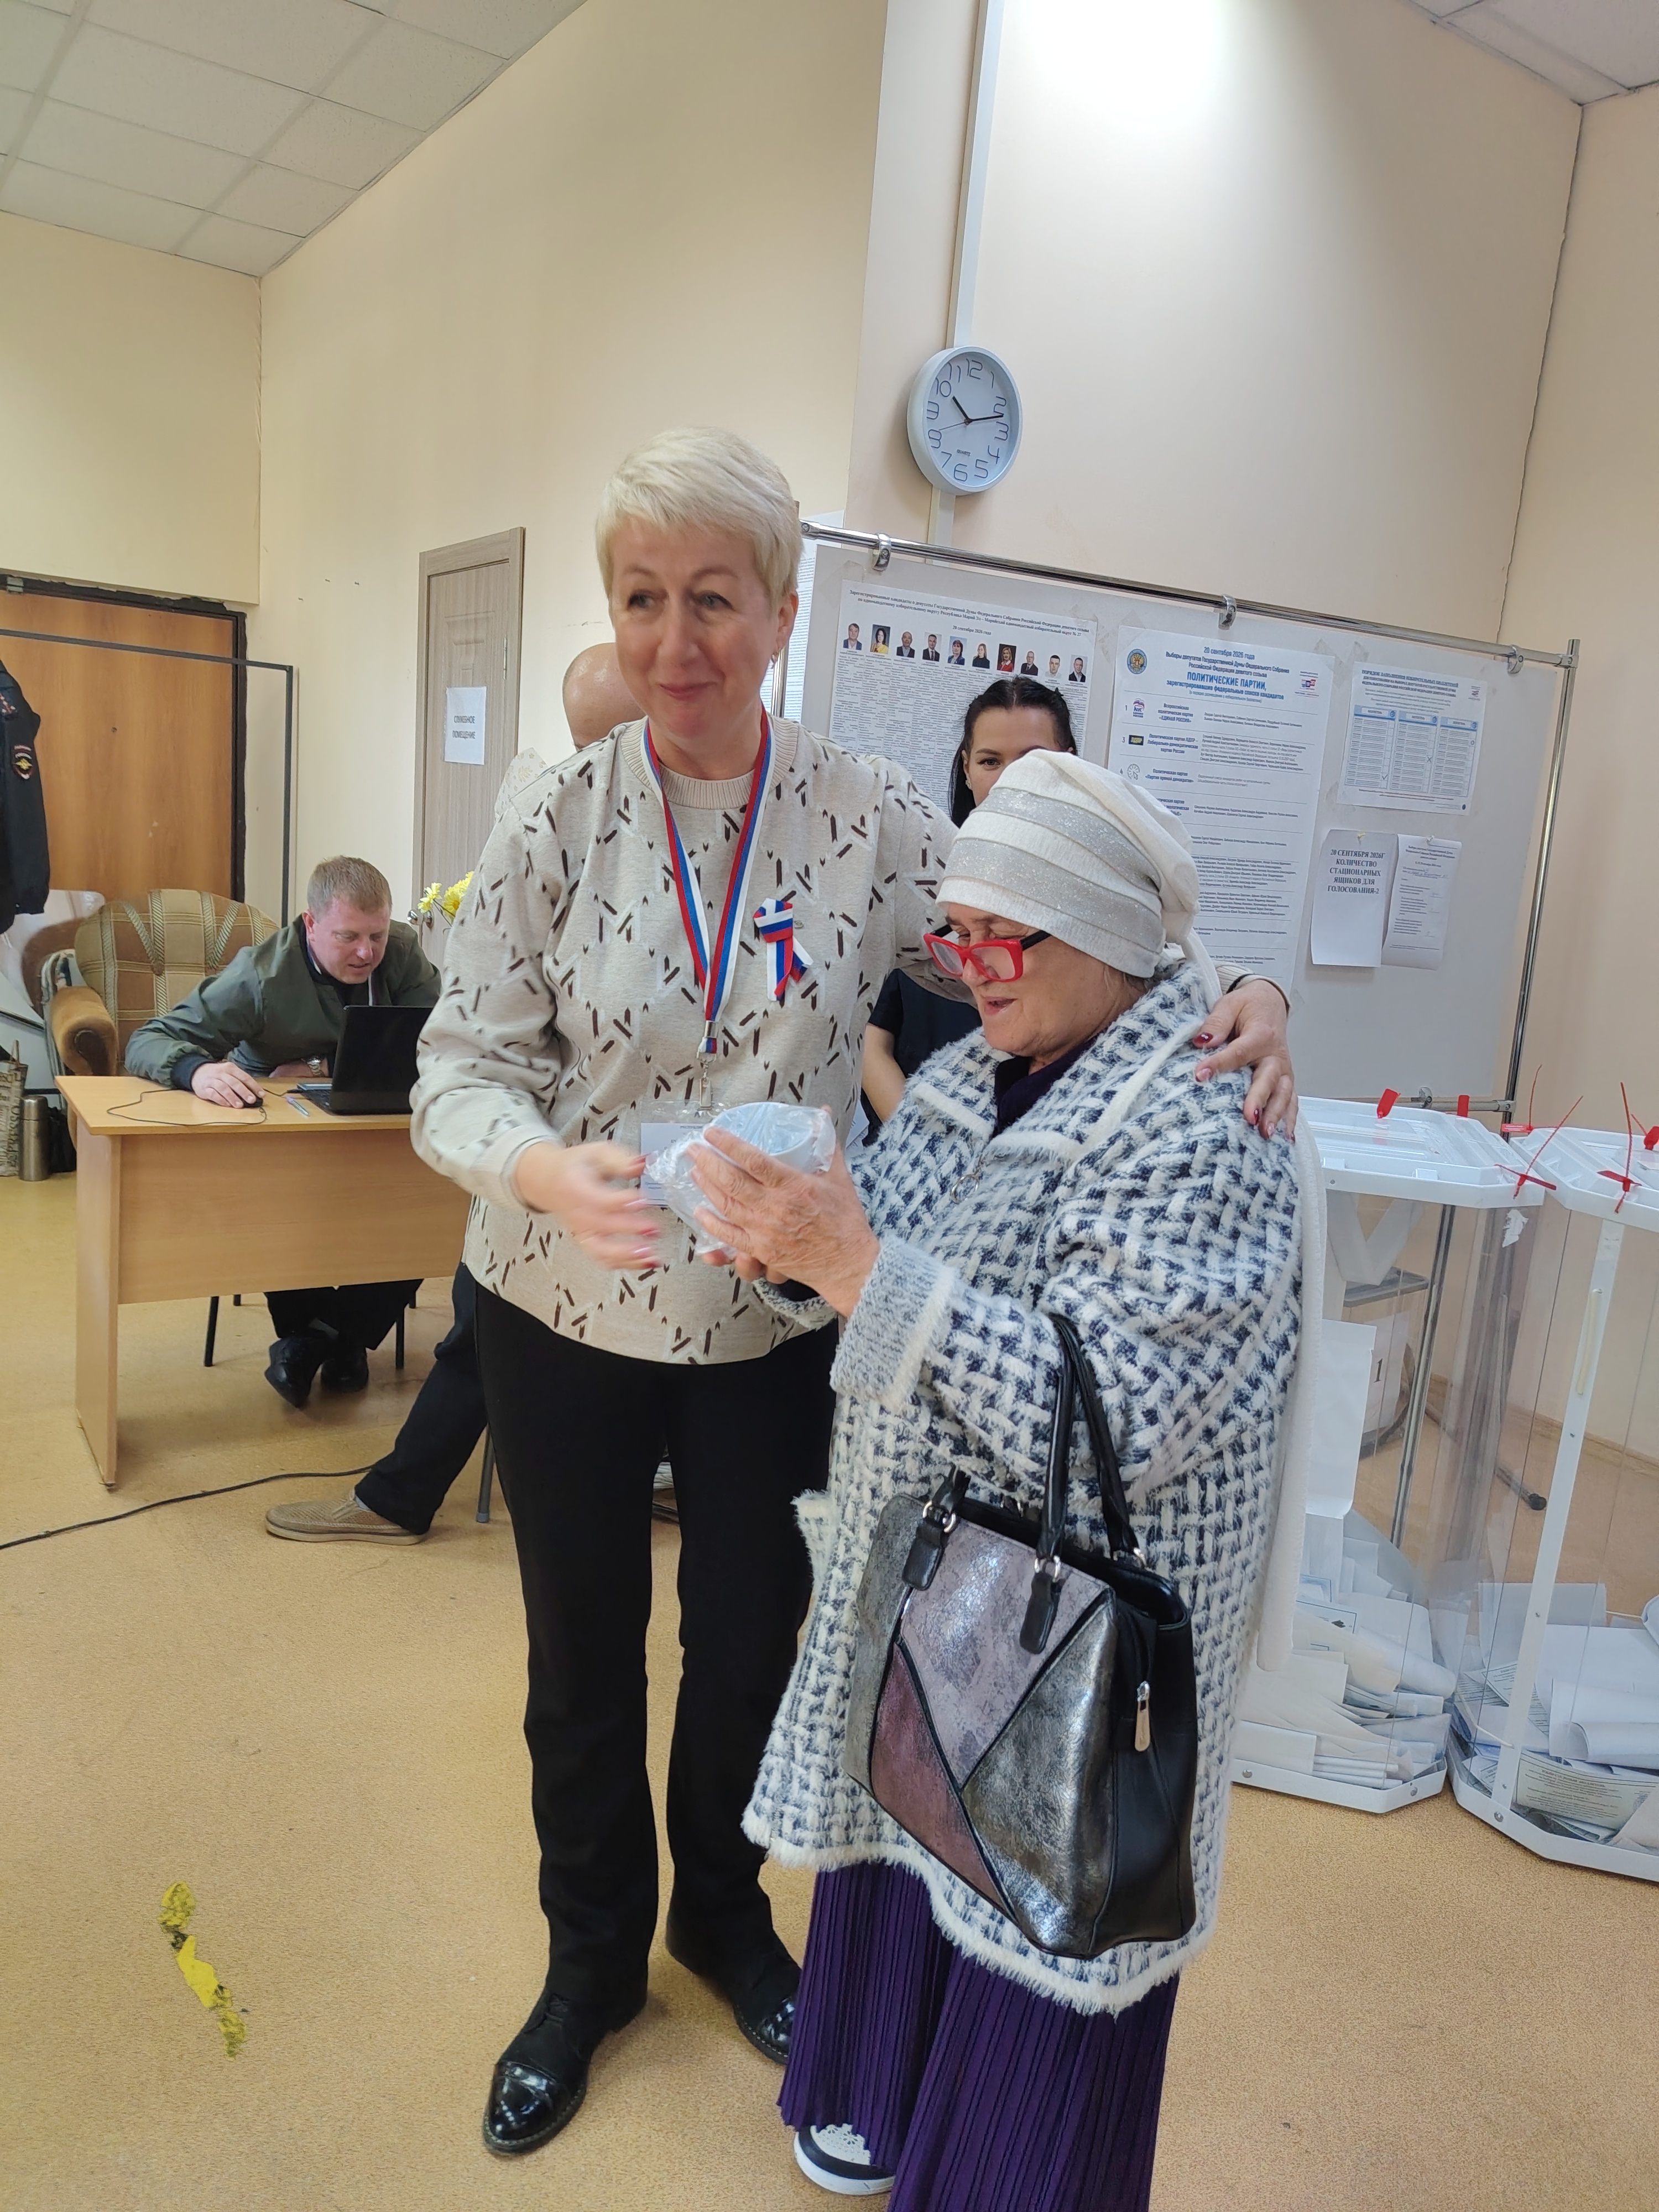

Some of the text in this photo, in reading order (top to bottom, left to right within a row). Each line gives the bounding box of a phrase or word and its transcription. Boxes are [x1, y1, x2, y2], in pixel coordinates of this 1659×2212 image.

[948, 362, 961, 383] 11
[966, 358, 983, 379] 12
[935, 377, 952, 397] 10
[990, 371, 994, 389] 1
[926, 401, 940, 420] 9
[994, 396, 1006, 415] 2
[928, 429, 942, 448] 8
[994, 421, 1009, 441] 3
[941, 451, 952, 468] 7
[988, 445, 1000, 464] 4
[953, 463, 968, 482] 6
[974, 459, 989, 478] 5
[1187, 671, 1266, 691] ПОЛИТИЧЕСКИЕ ПАРТИИ,
[1335, 859, 1377, 867] КОЛИЧЕСТВО
[1337, 849, 1369, 858] СЕНТЯБРЯ
[1329, 868, 1381, 877] СТАЦИОНАРНЫХ
[1328, 885, 1379, 894] ГОЛОСОВАНИЯ-2
[1373, 1358, 1383, 1383] 1
